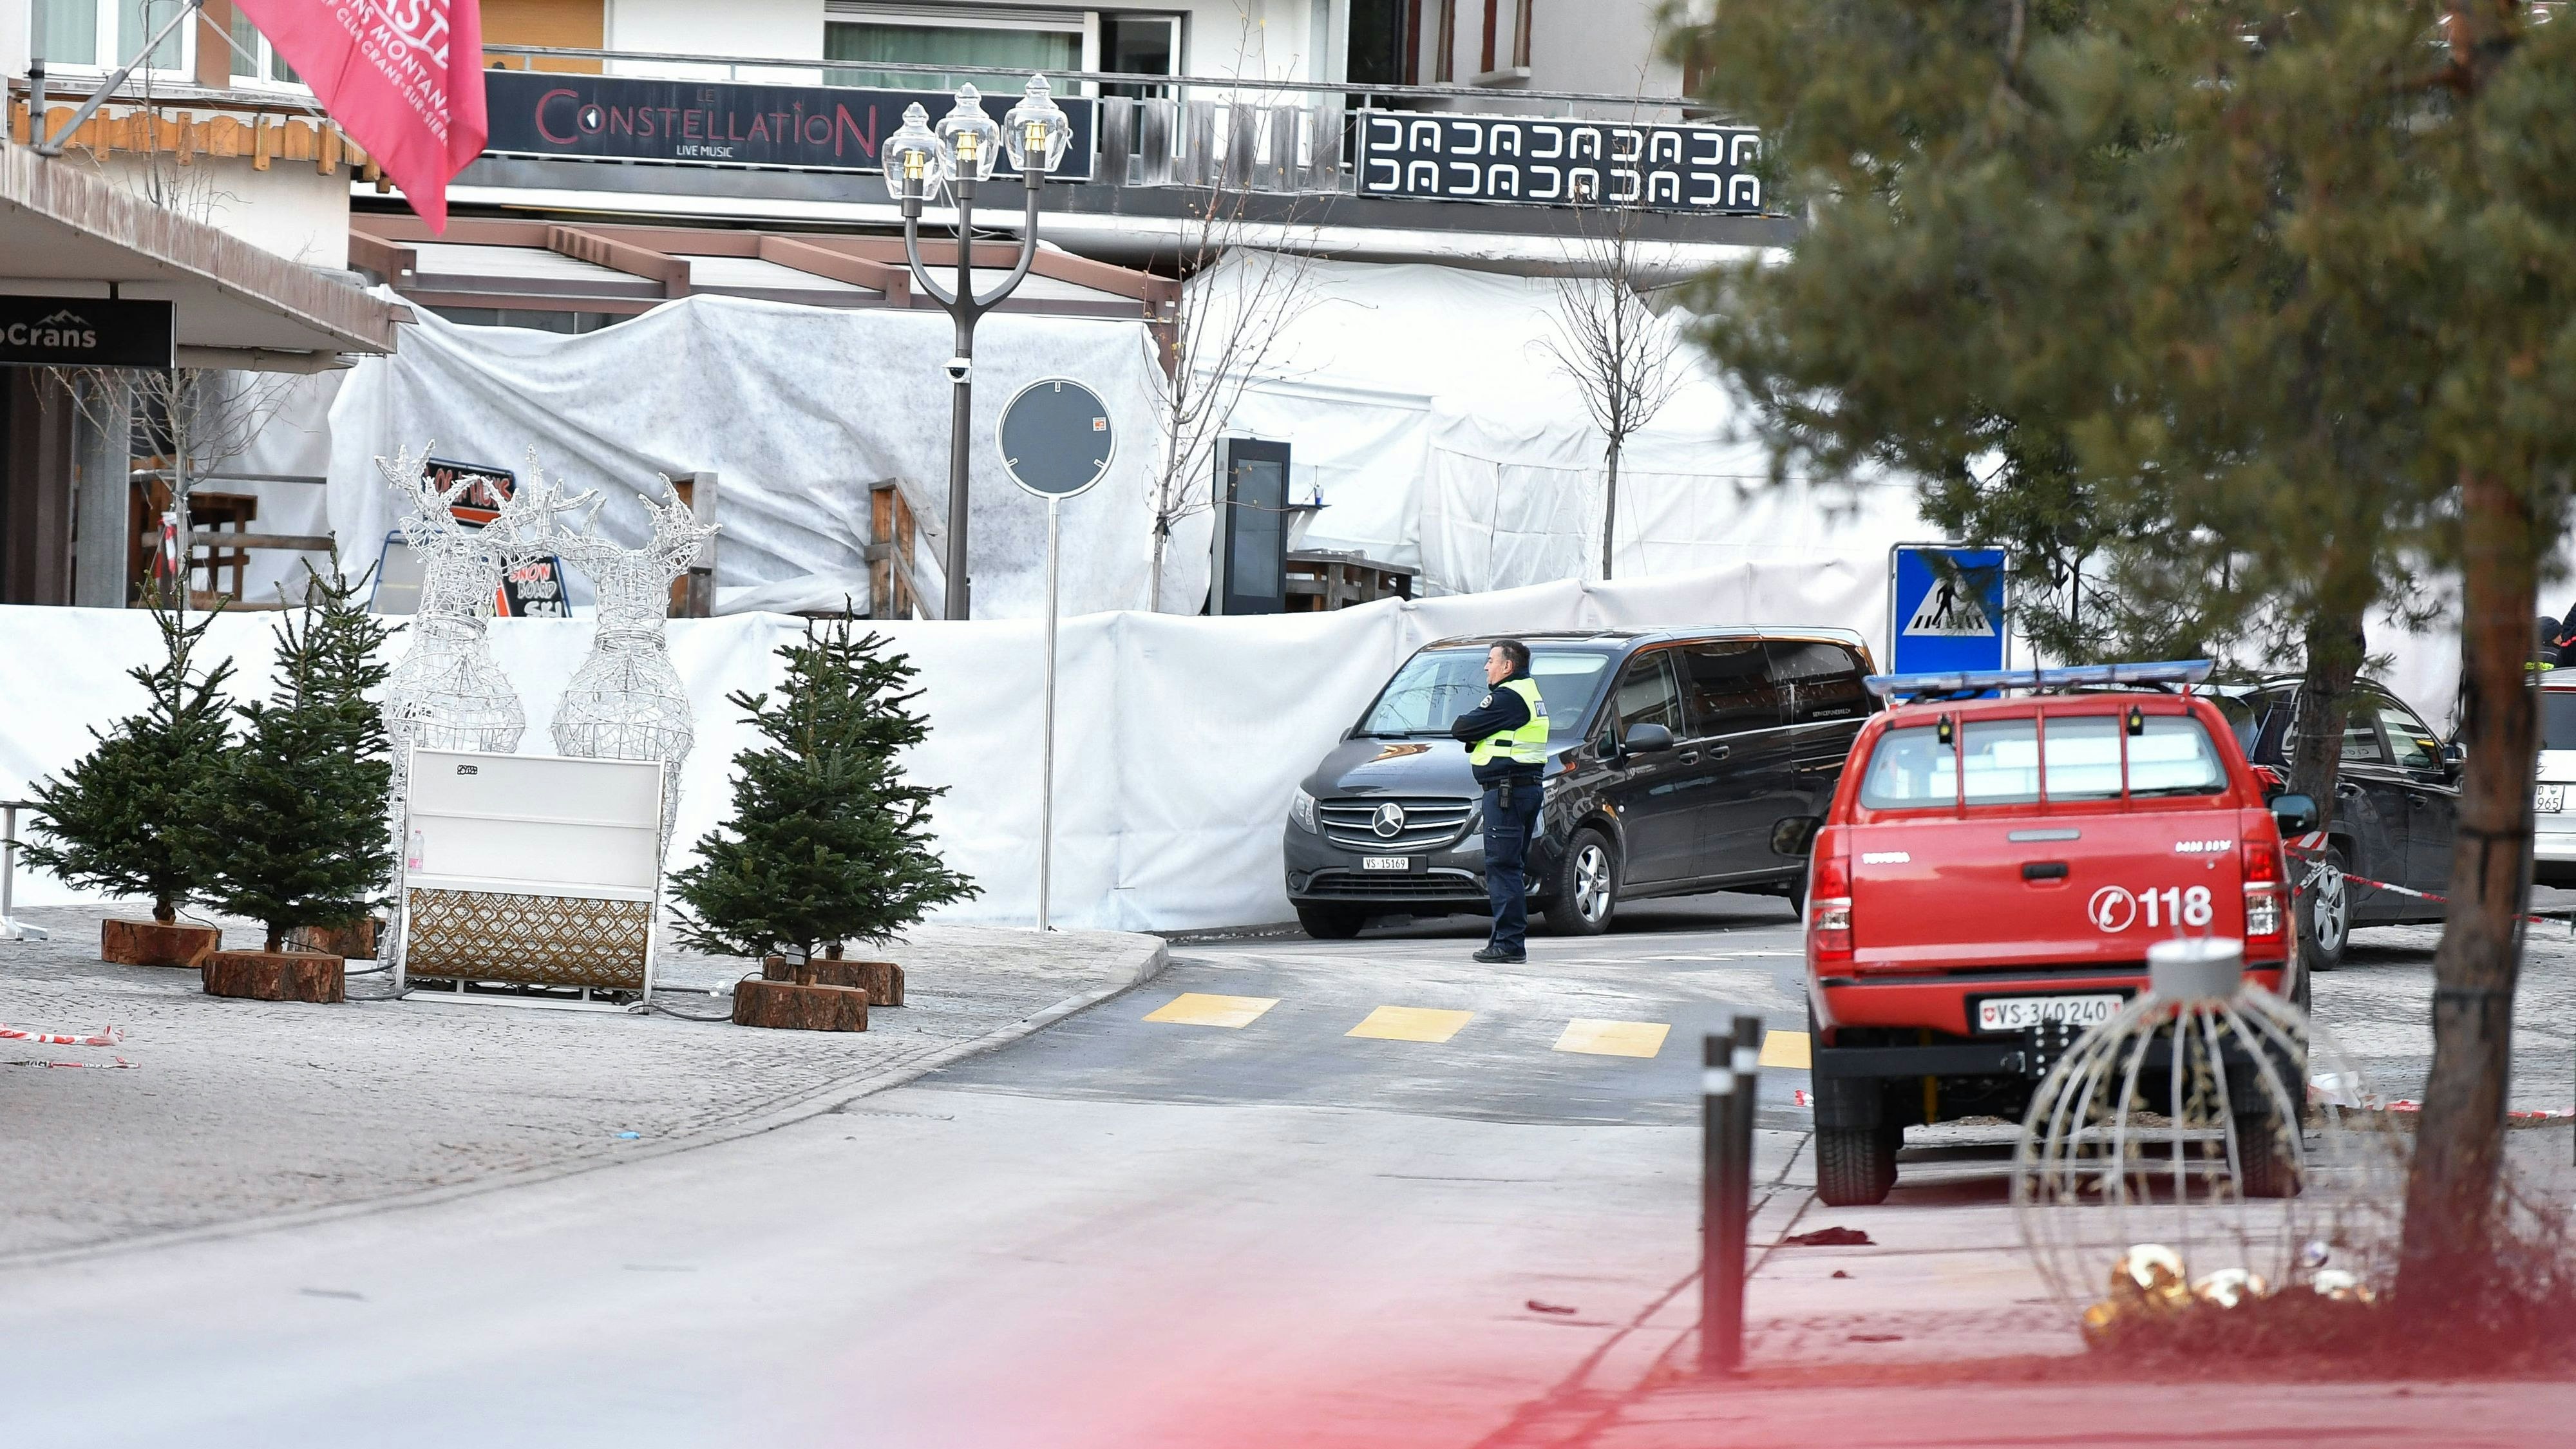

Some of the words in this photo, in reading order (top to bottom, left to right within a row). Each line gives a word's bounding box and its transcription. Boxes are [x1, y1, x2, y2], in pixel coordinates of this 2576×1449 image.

[696, 88, 715, 103] LE
[676, 145, 699, 156] LIVE
[700, 146, 734, 158] MUSIC
[0, 322, 97, 348] Crans
[509, 563, 551, 582] SNOW
[517, 581, 557, 600] BOARD
[524, 601, 563, 618] SKI
[2137, 885, 2213, 928] 118
